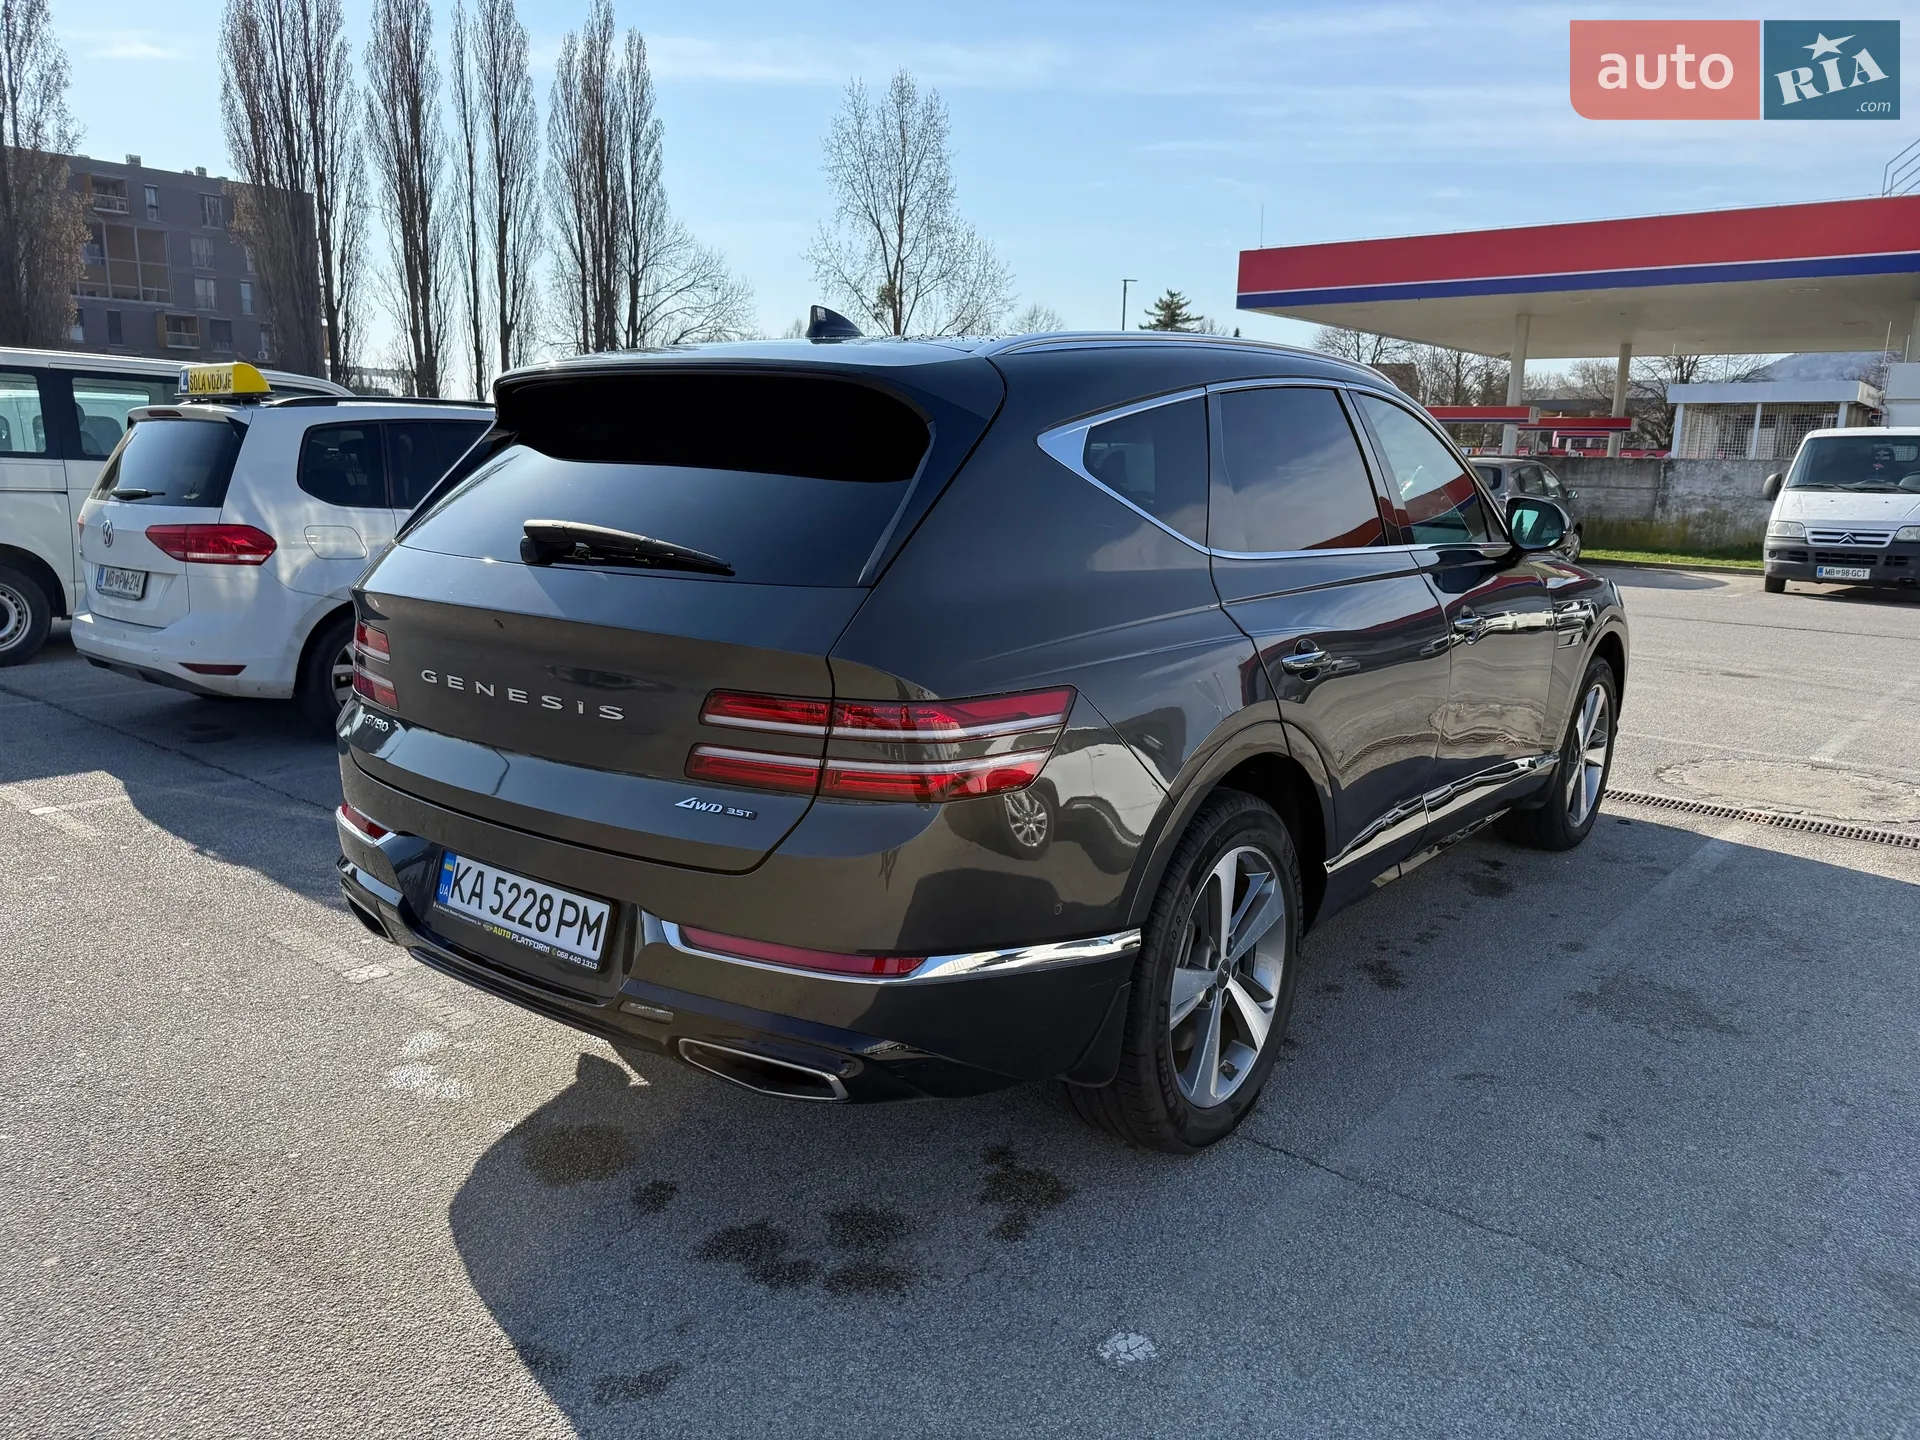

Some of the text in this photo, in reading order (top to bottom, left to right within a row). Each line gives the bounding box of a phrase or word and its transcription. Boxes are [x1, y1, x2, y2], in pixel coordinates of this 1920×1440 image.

[189, 371, 207, 391] ŠOLA
[207, 370, 232, 391] VOŽNJE
[1824, 568, 1836, 576] MB
[420, 669, 625, 721] GENESIS
[365, 714, 389, 733] GV80
[674, 797, 723, 813] 4WD
[439, 883, 449, 897] UA
[450, 862, 485, 910] KA
[488, 876, 554, 933] 5228
[555, 898, 605, 952] PM
[493, 926, 598, 970] AUTO PLATFORM 068 440 1313
